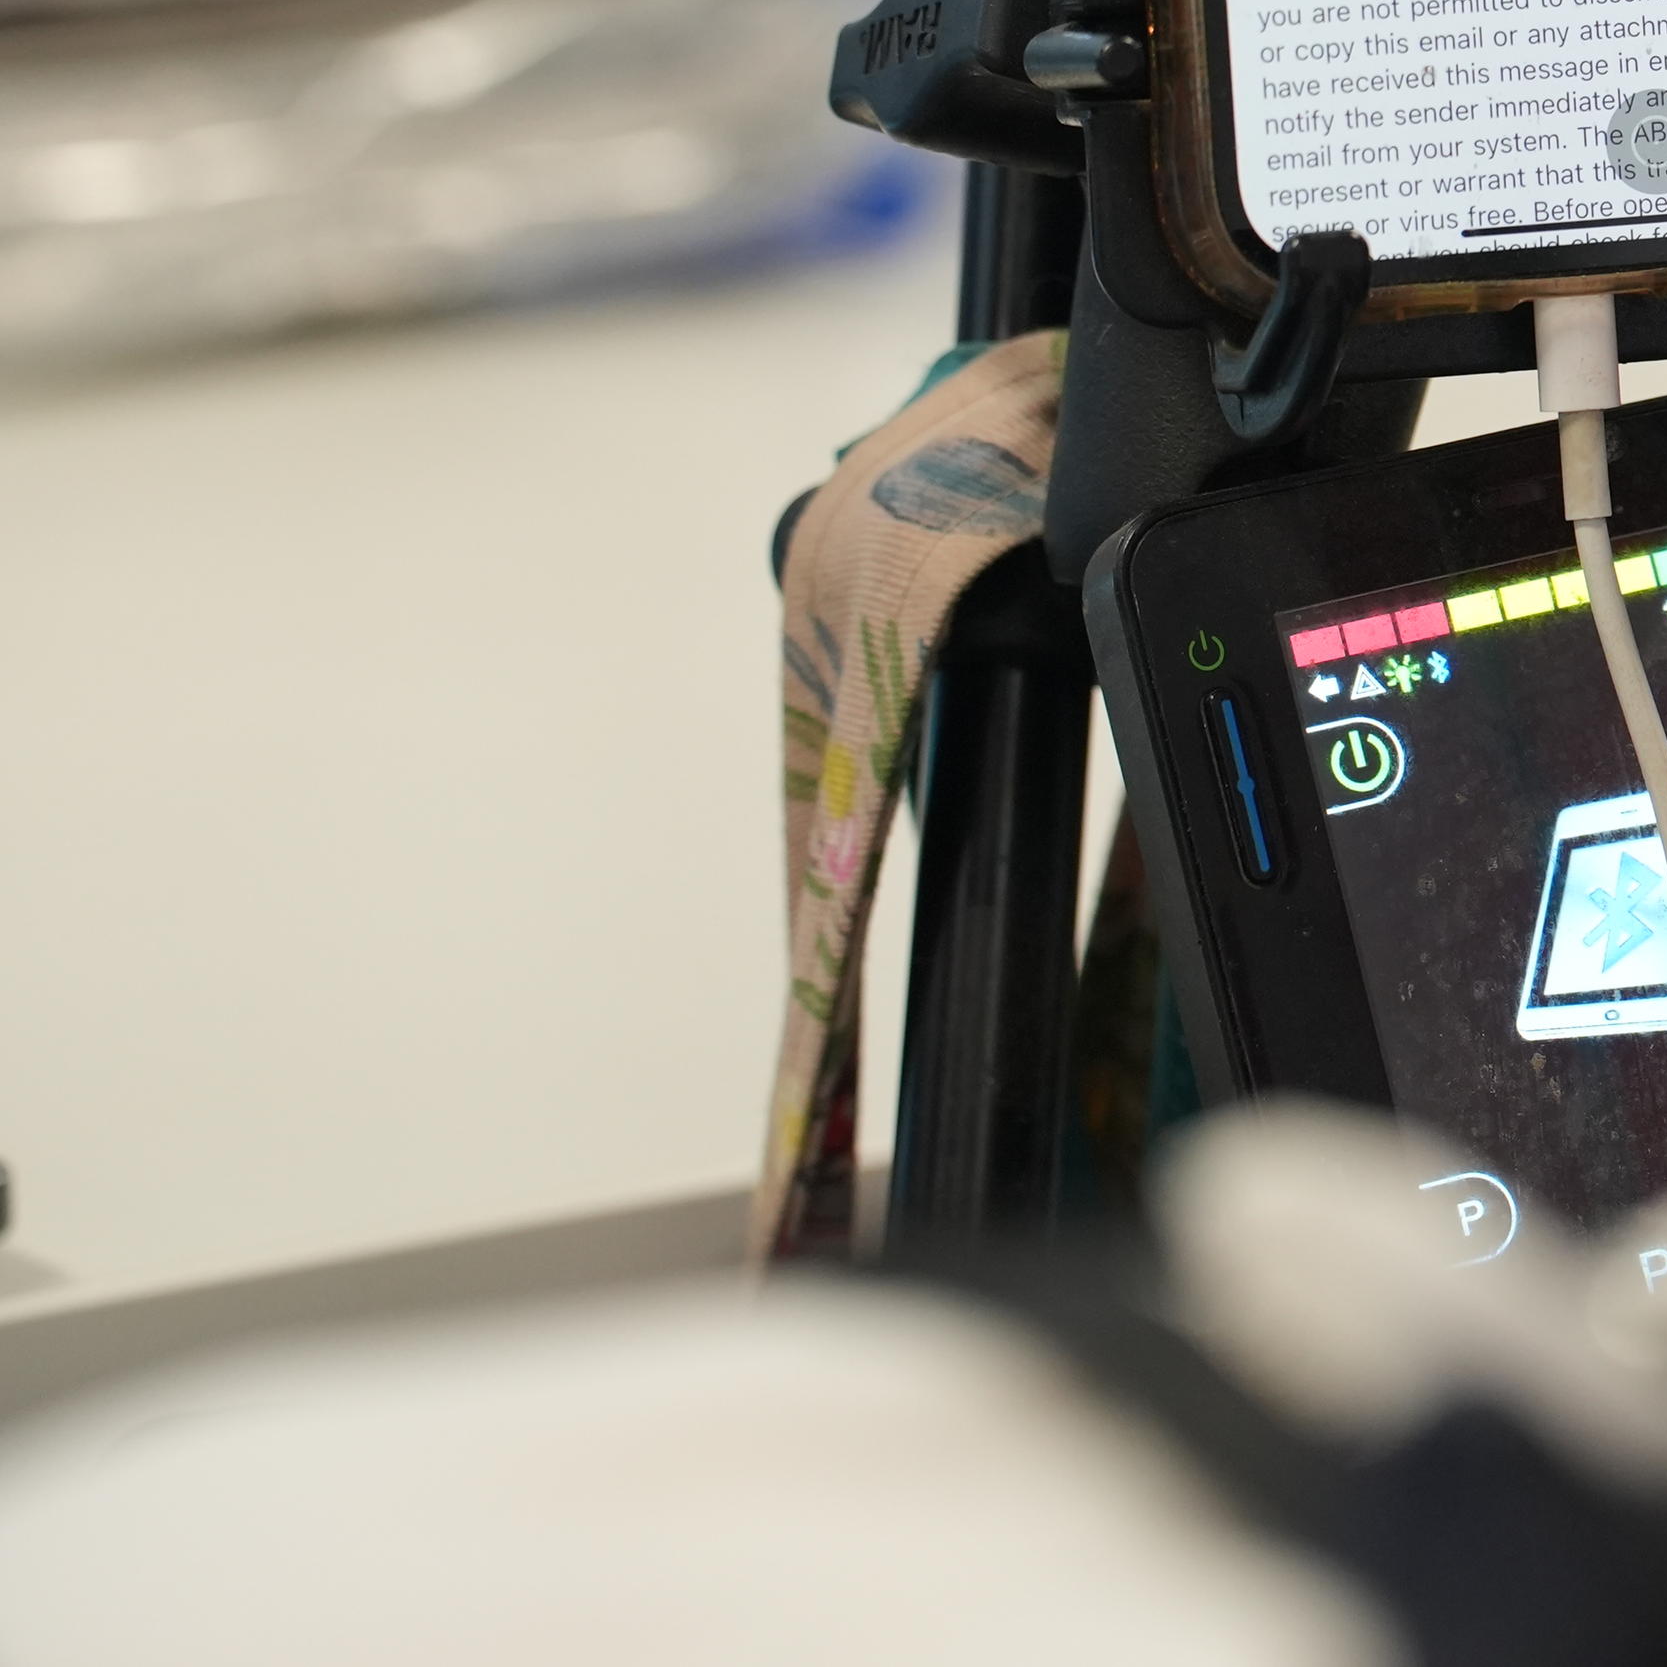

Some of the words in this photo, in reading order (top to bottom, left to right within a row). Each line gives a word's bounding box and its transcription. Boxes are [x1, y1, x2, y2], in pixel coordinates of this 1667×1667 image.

[1257, 8, 1302, 34] you
[1312, 5, 1351, 25] are
[1264, 109, 1335, 137] notify
[1344, 106, 1384, 130] the
[1394, 99, 1480, 126] sender
[1488, 88, 1637, 120] immediately
[1457, 1199, 1485, 1237] P
